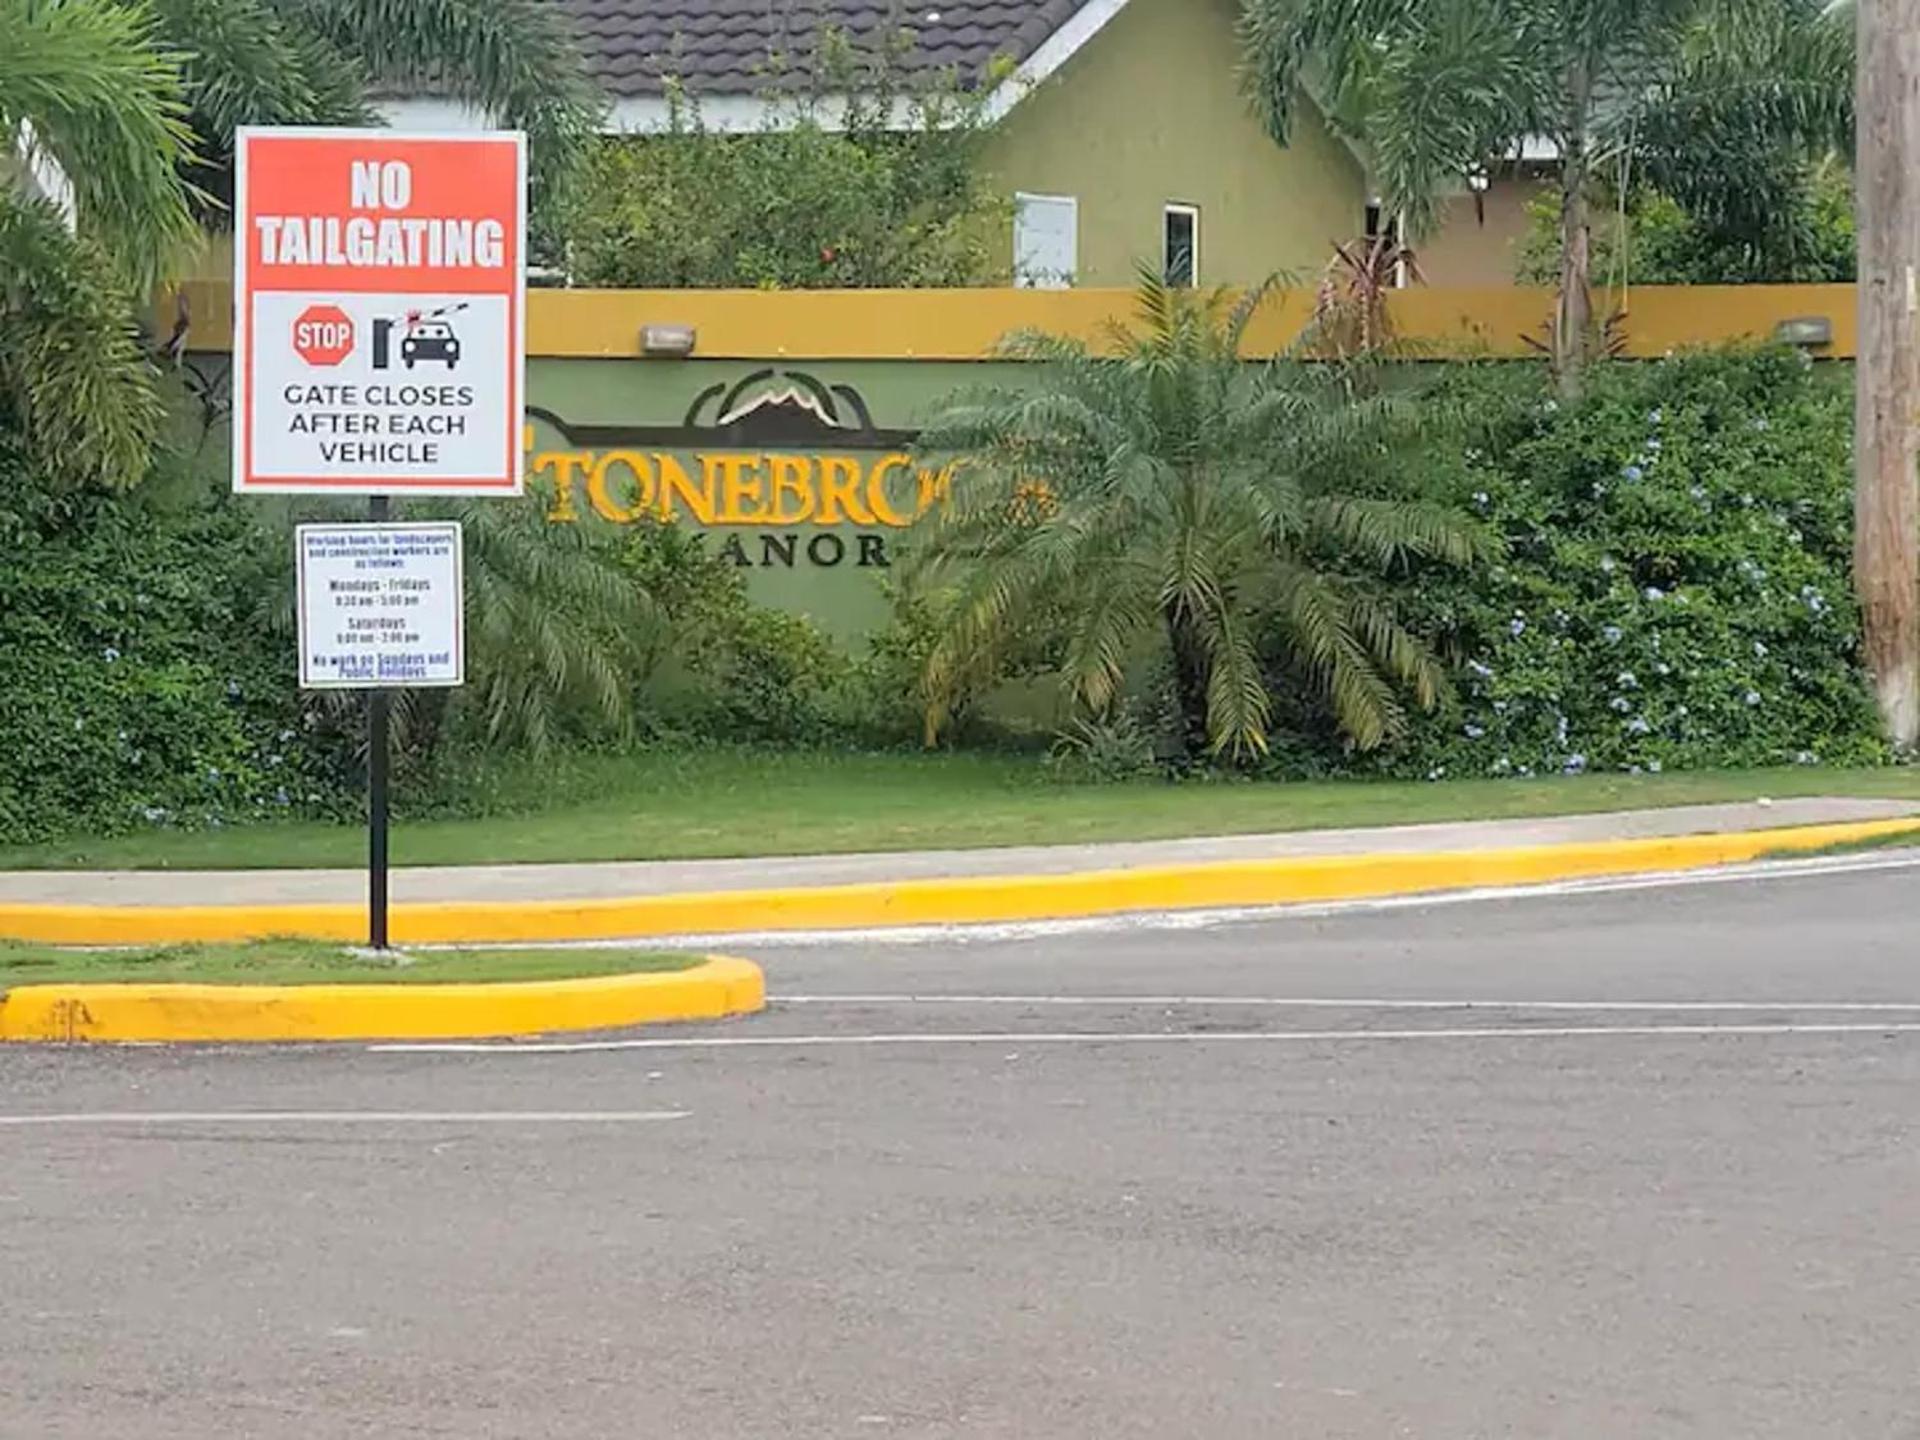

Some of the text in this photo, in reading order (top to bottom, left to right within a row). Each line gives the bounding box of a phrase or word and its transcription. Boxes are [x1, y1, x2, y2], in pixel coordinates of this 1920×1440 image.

[350, 160, 412, 211] NO
[255, 216, 505, 268] TAILGATING
[297, 321, 351, 349] STOP
[283, 385, 474, 407] GATE CLOSES
[288, 414, 466, 435] AFTER EACH
[318, 442, 439, 463] VEHICLE
[684, 532, 892, 567] ANOR
[329, 579, 380, 593] Mondays
[388, 578, 431, 593] Fridays
[347, 617, 406, 630] Saturdays
[330, 654, 358, 666] work
[378, 651, 425, 666] Sundays
[427, 650, 449, 664] and
